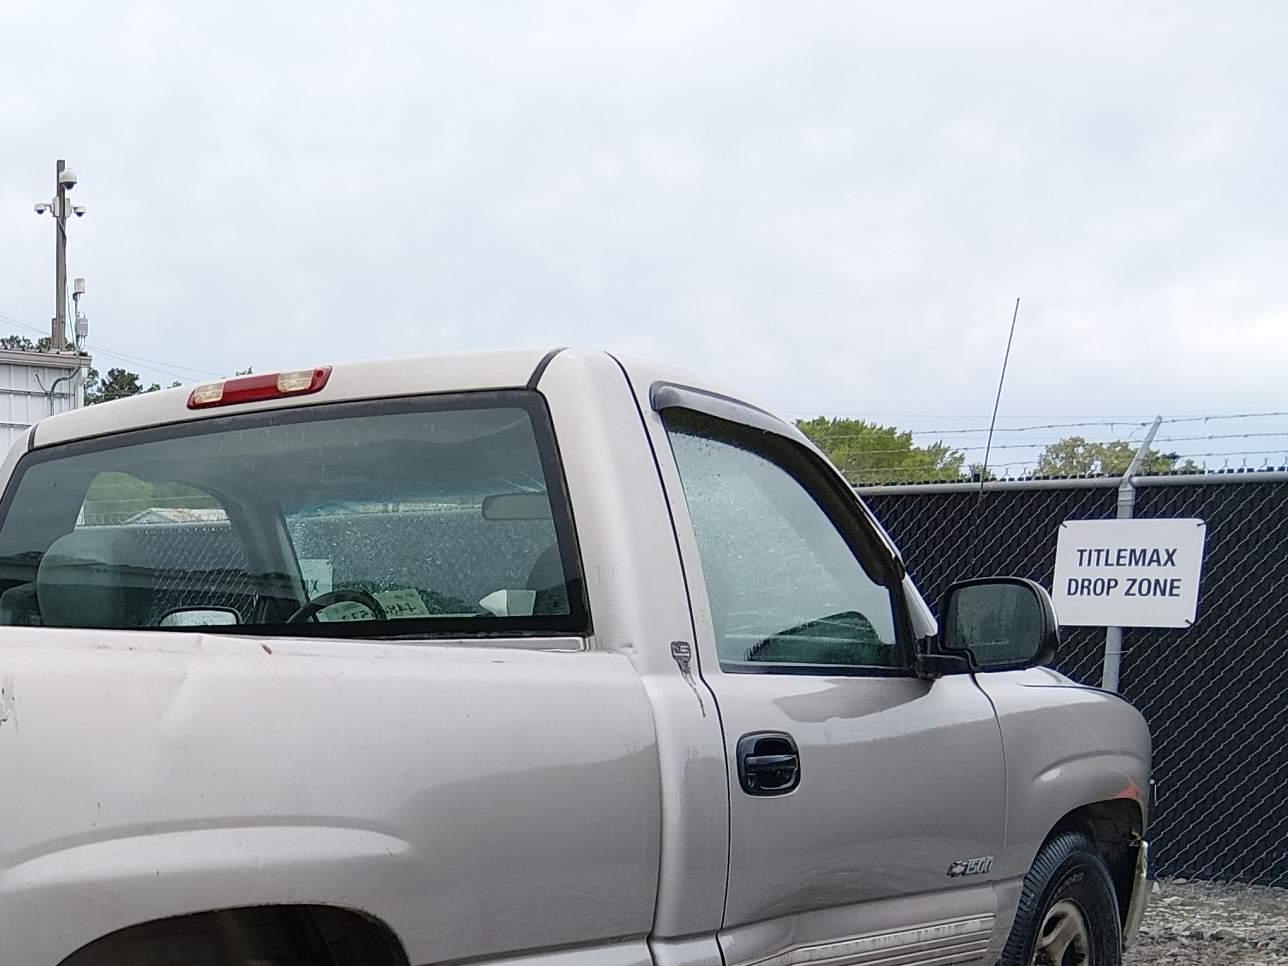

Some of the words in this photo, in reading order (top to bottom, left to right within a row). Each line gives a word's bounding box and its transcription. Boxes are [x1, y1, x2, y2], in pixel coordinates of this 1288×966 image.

[1076, 548, 1178, 568] TITLEMAX
[1067, 578, 1119, 597] DROP
[1124, 578, 1182, 597] ZONE
